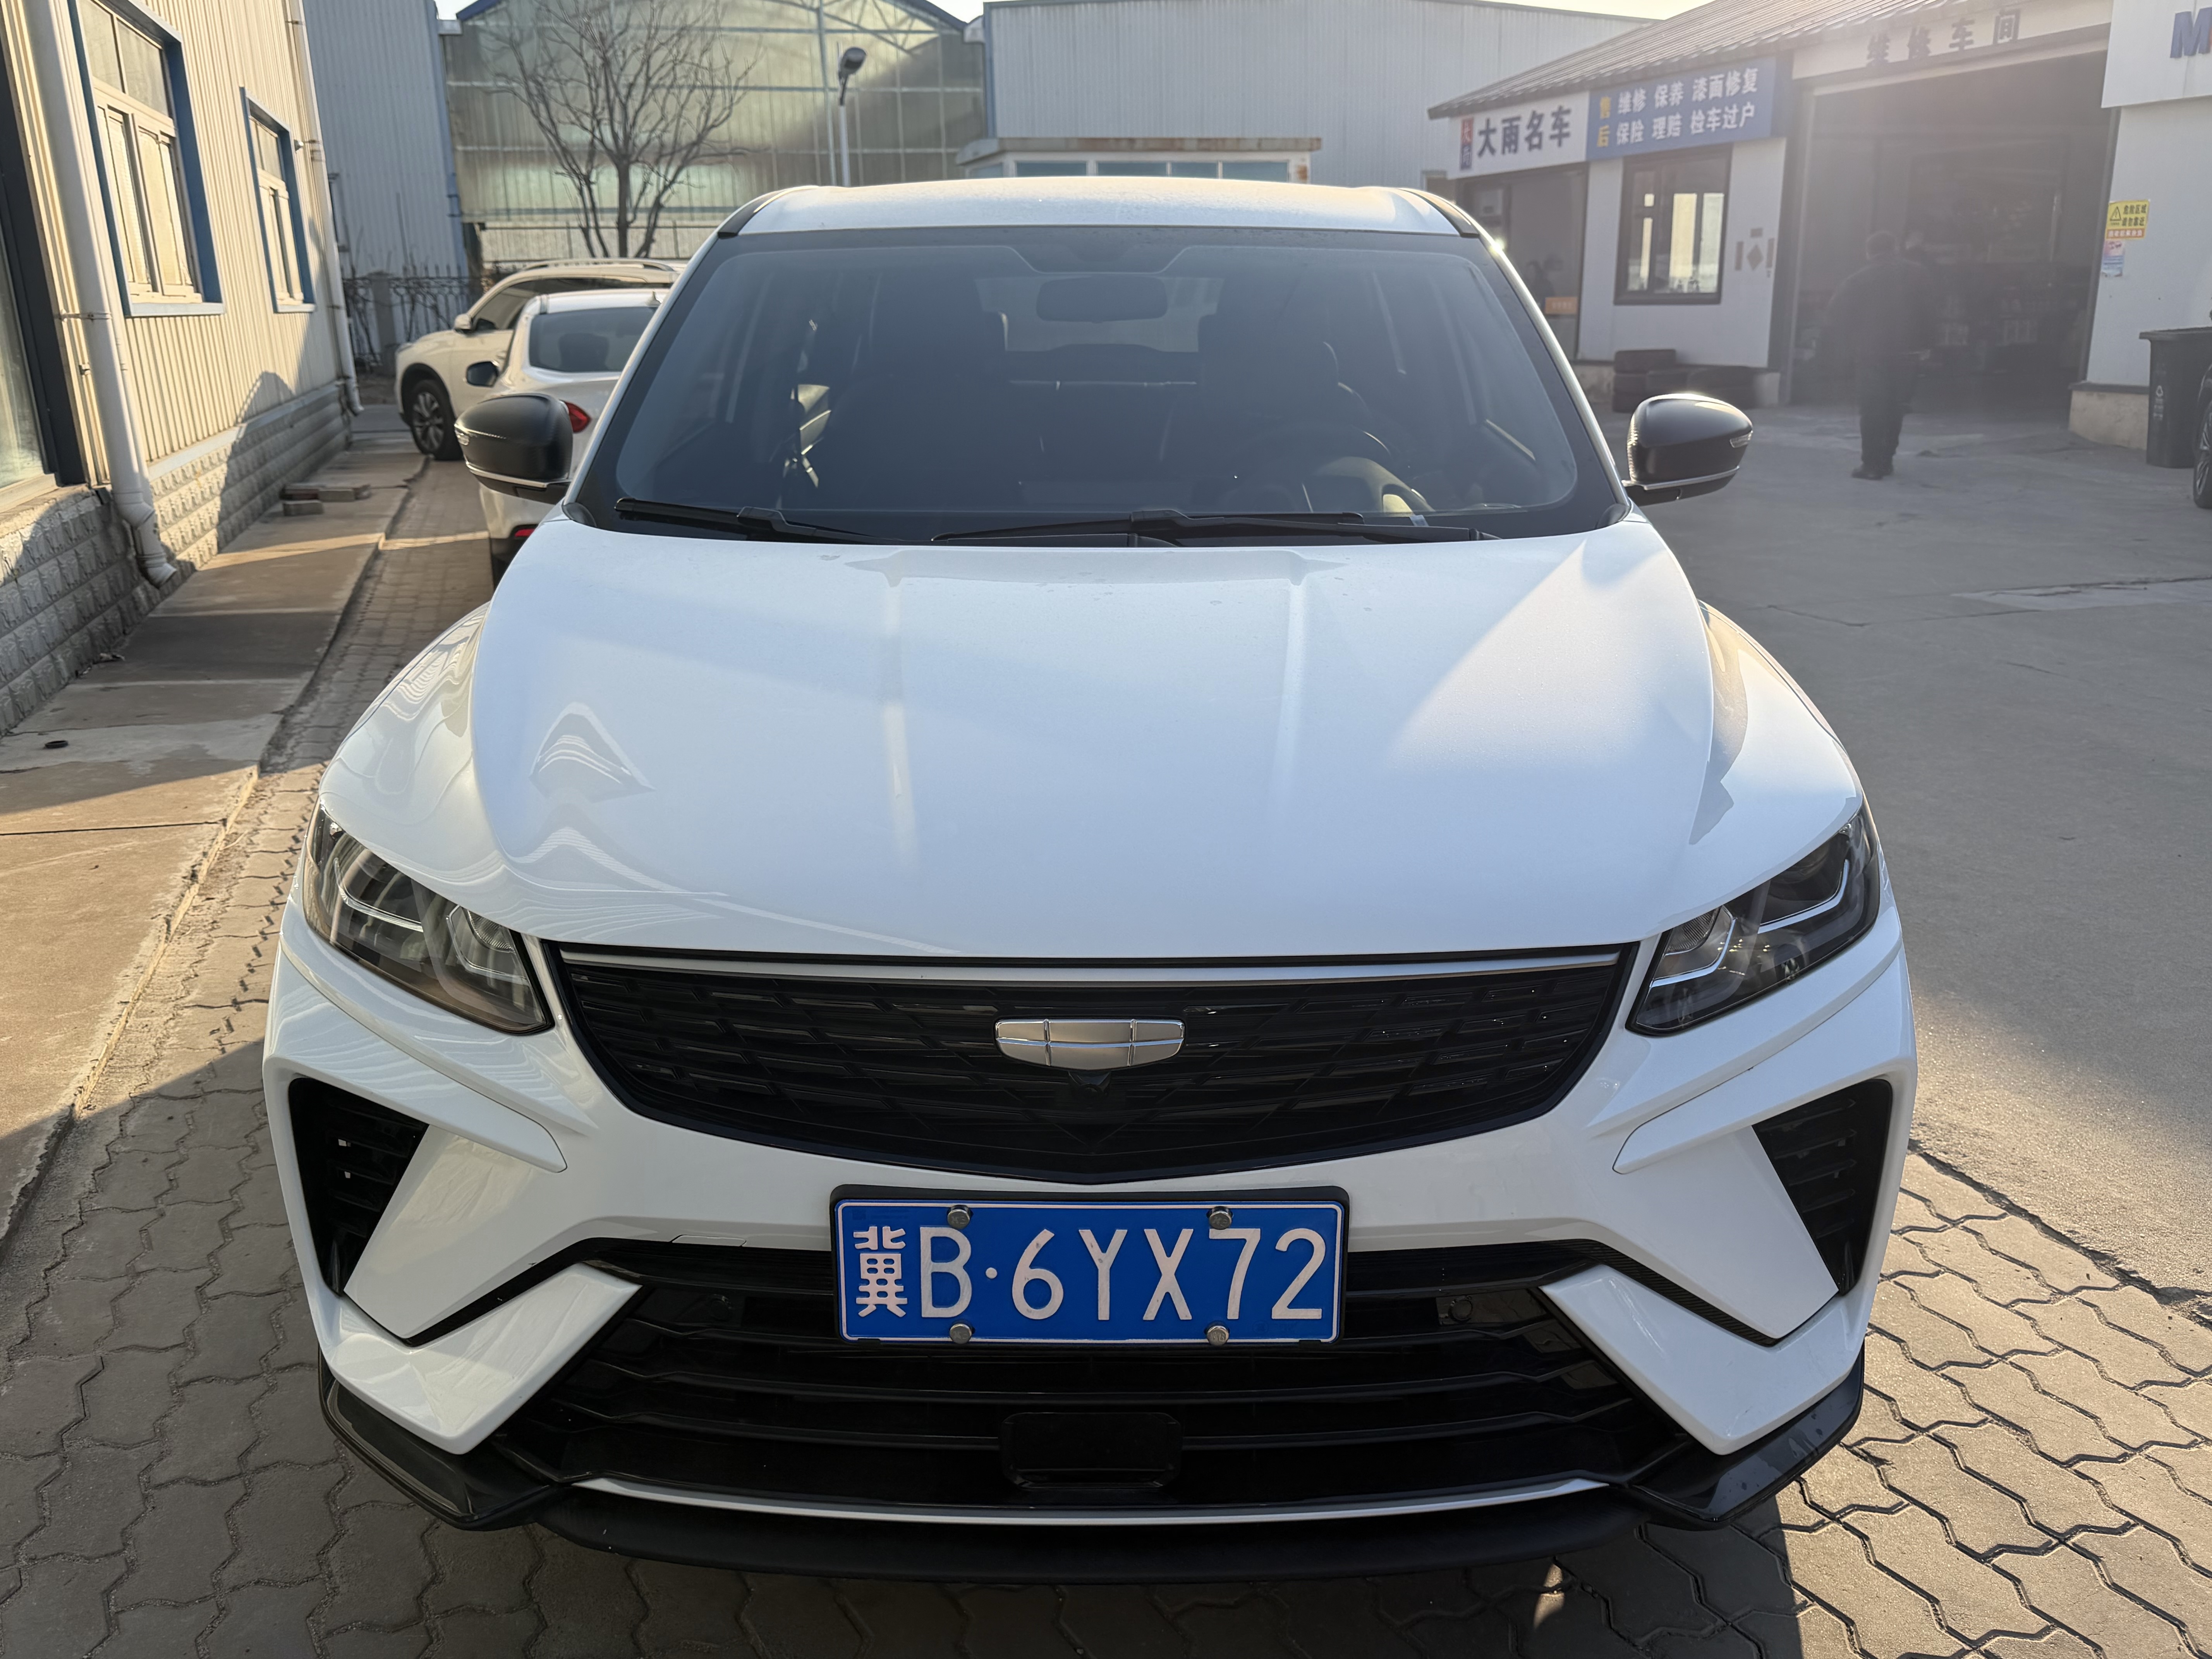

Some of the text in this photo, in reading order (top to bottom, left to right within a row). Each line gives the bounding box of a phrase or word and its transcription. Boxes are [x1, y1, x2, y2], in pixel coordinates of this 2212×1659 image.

[2170, 7, 2212, 58] M
[1618, 68, 1758, 114] 维修 保养 漆面修复
[1477, 105, 1571, 158] 大雨名车
[1616, 101, 1755, 146] 保险 理赔 检车过户
[853, 1226, 1326, 1321] 冀B·6YX72
